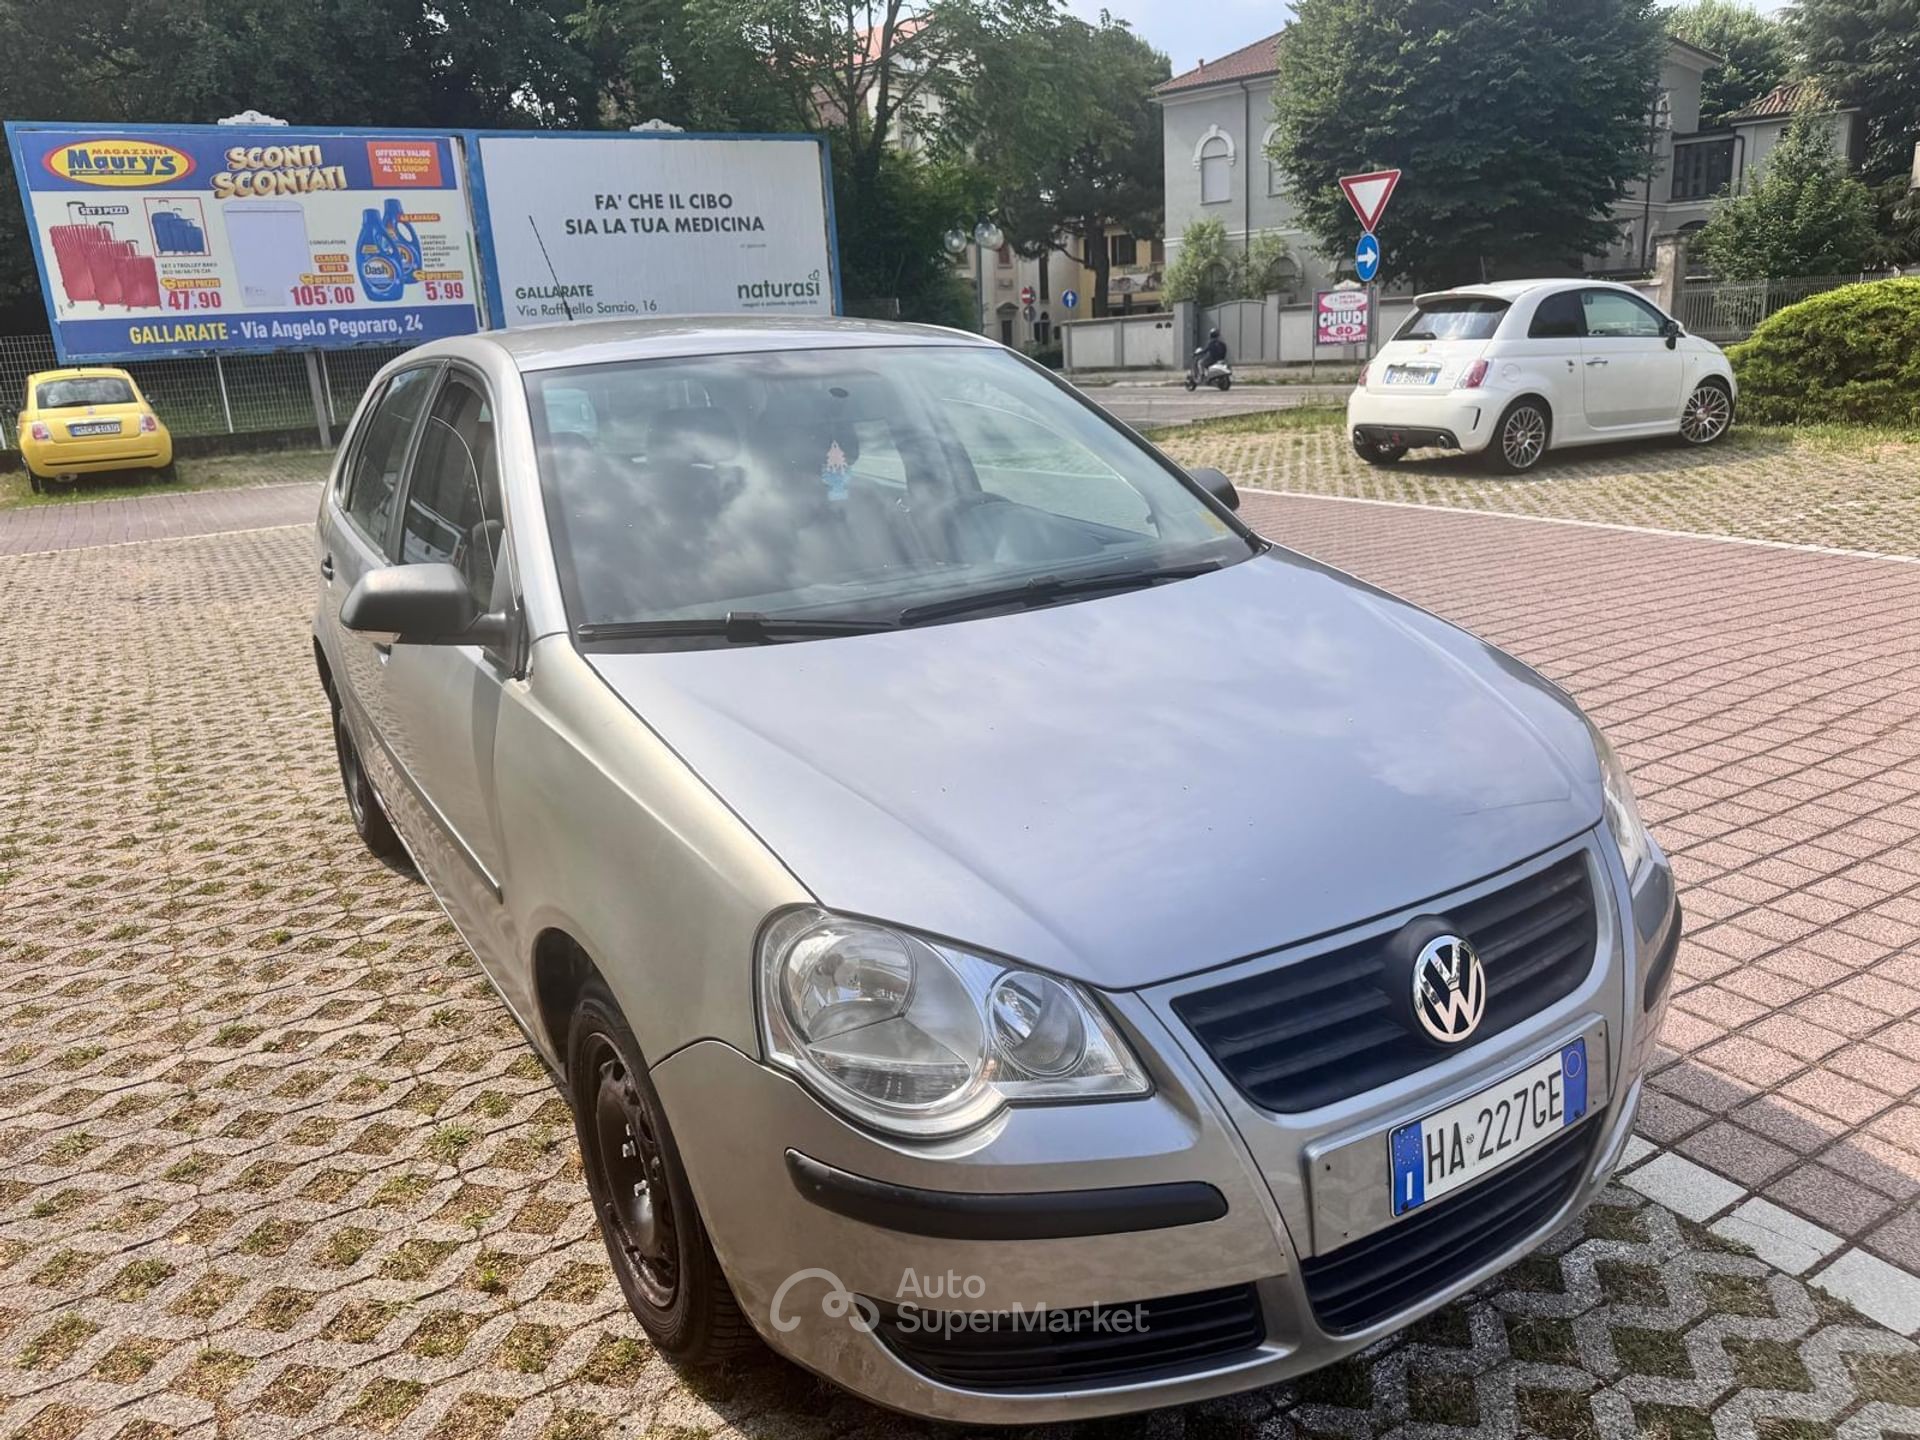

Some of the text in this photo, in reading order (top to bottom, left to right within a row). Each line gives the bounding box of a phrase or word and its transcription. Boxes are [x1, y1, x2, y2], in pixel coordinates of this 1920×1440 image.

[226, 143, 323, 171] SCONTI
[376, 149, 431, 157] OFFERTE VALIDE
[403, 157, 430, 165] MAGGIO
[67, 149, 177, 177] Maury's
[213, 165, 348, 200] SCONTATI
[594, 193, 733, 211] FA' CHE IL CIBO
[565, 216, 765, 235] SIA LA TUA MEDICINA
[515, 284, 594, 300] GALLARATE
[517, 303, 538, 317] Via
[597, 301, 639, 315] Sanzio,
[642, 299, 658, 312] 16
[129, 322, 229, 345] GALLARATE
[240, 320, 267, 339] Via
[271, 318, 327, 340] Angelo
[328, 317, 403, 338] Pegoraro,
[404, 313, 424, 331] 24
[1426, 1069, 1563, 1184] HA 227GE
